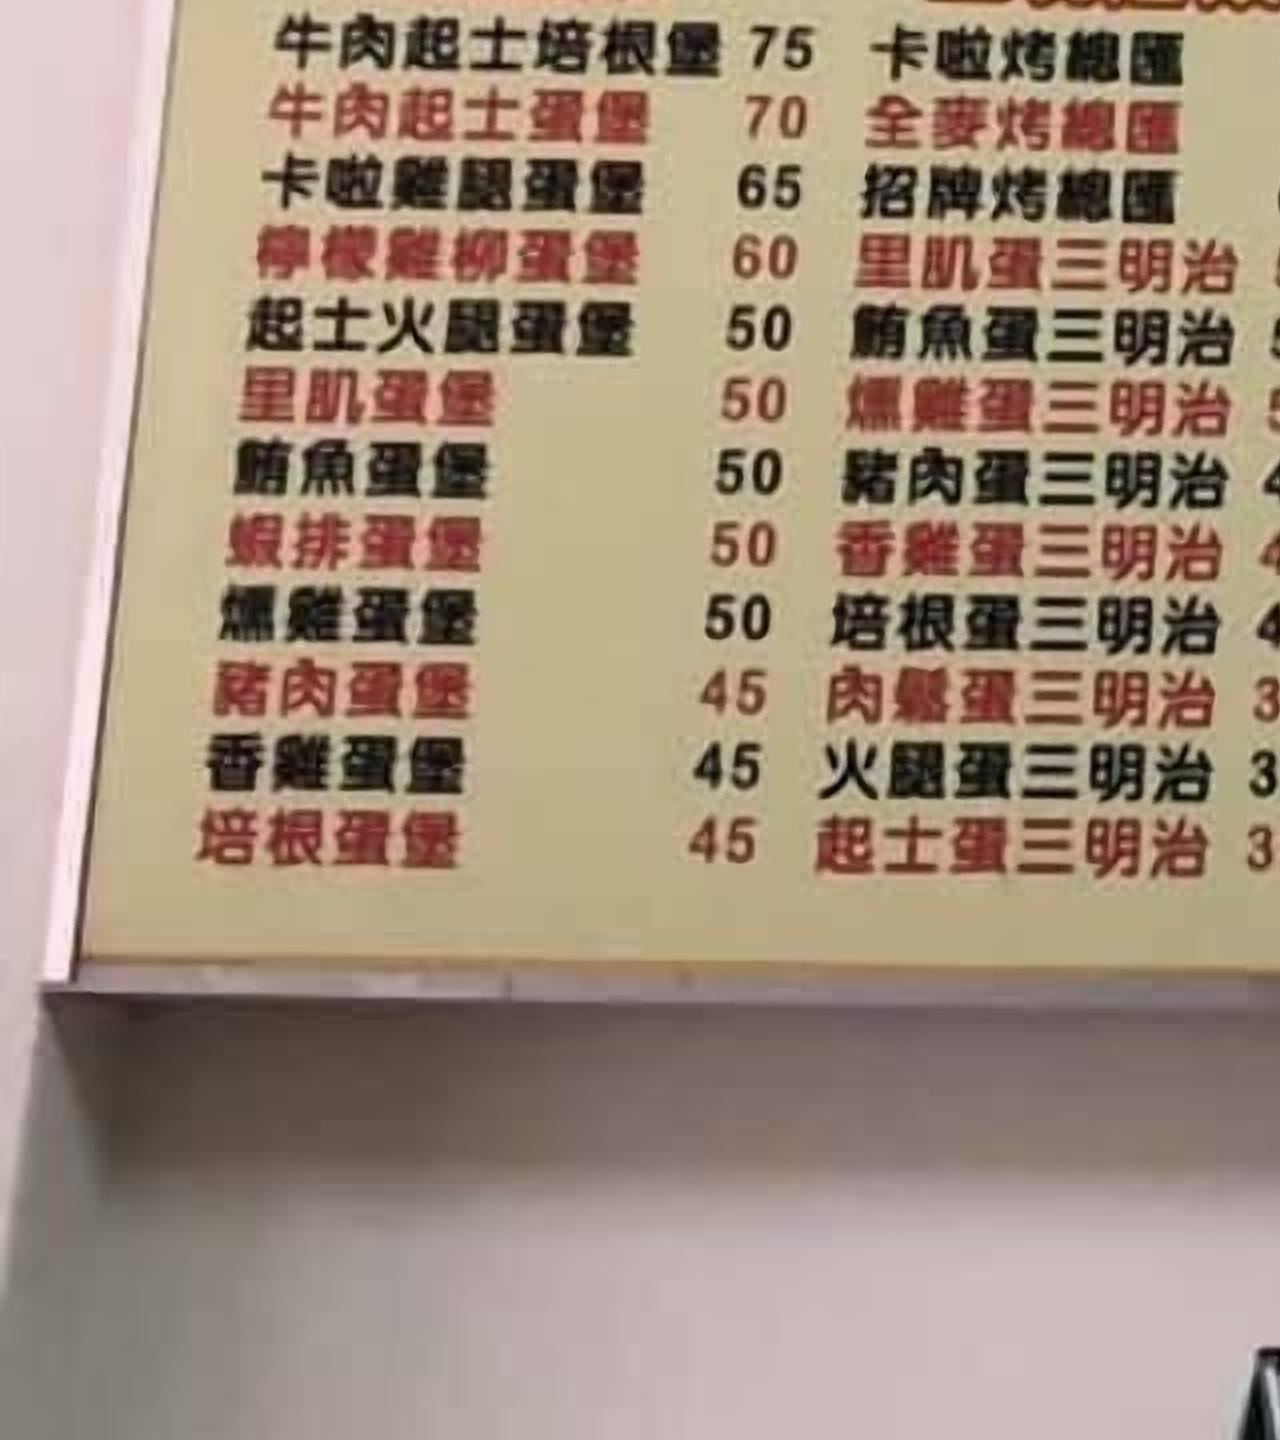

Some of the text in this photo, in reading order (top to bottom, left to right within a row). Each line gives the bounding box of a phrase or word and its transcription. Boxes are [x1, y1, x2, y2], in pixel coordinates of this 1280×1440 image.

[274, 12, 814, 78] 牛肉起士培根堡 75
[870, 23, 1184, 86] 卡啦烤總匯
[268, 82, 807, 145] 牛肉起士蛋堡 70
[865, 94, 1181, 155] 全麥烤總匯
[261, 151, 802, 215] 卡啦雞腿蛋堡 65
[860, 162, 1179, 225] 招牌烤總匯
[733, 234, 798, 279] 60
[854, 233, 1238, 295] 里肌蛋三明治
[245, 294, 792, 357] 起士火腿蛋堡 50
[849, 301, 1235, 368] 鮪魚蛋三明治
[238, 366, 786, 427] 里肌蛋堡 50
[233, 436, 782, 500] 鮪魚蛋堡 50
[841, 446, 1229, 511] 豬肉蛋三明治
[711, 521, 777, 567] 50
[836, 519, 1223, 582] 香雞蛋三明治
[705, 593, 771, 641] 50
[829, 591, 1222, 656] 培根蛋三明治
[213, 657, 766, 720] 豬肉蛋堡 45
[827, 664, 1215, 730] 肉鬆蛋三明治
[205, 731, 762, 795] 香雞蛋堡 45
[818, 738, 1214, 804] 火腿蛋三明治
[196, 807, 755, 869] 培根蛋堡 45
[815, 814, 1209, 879] 起士蛋三明治
